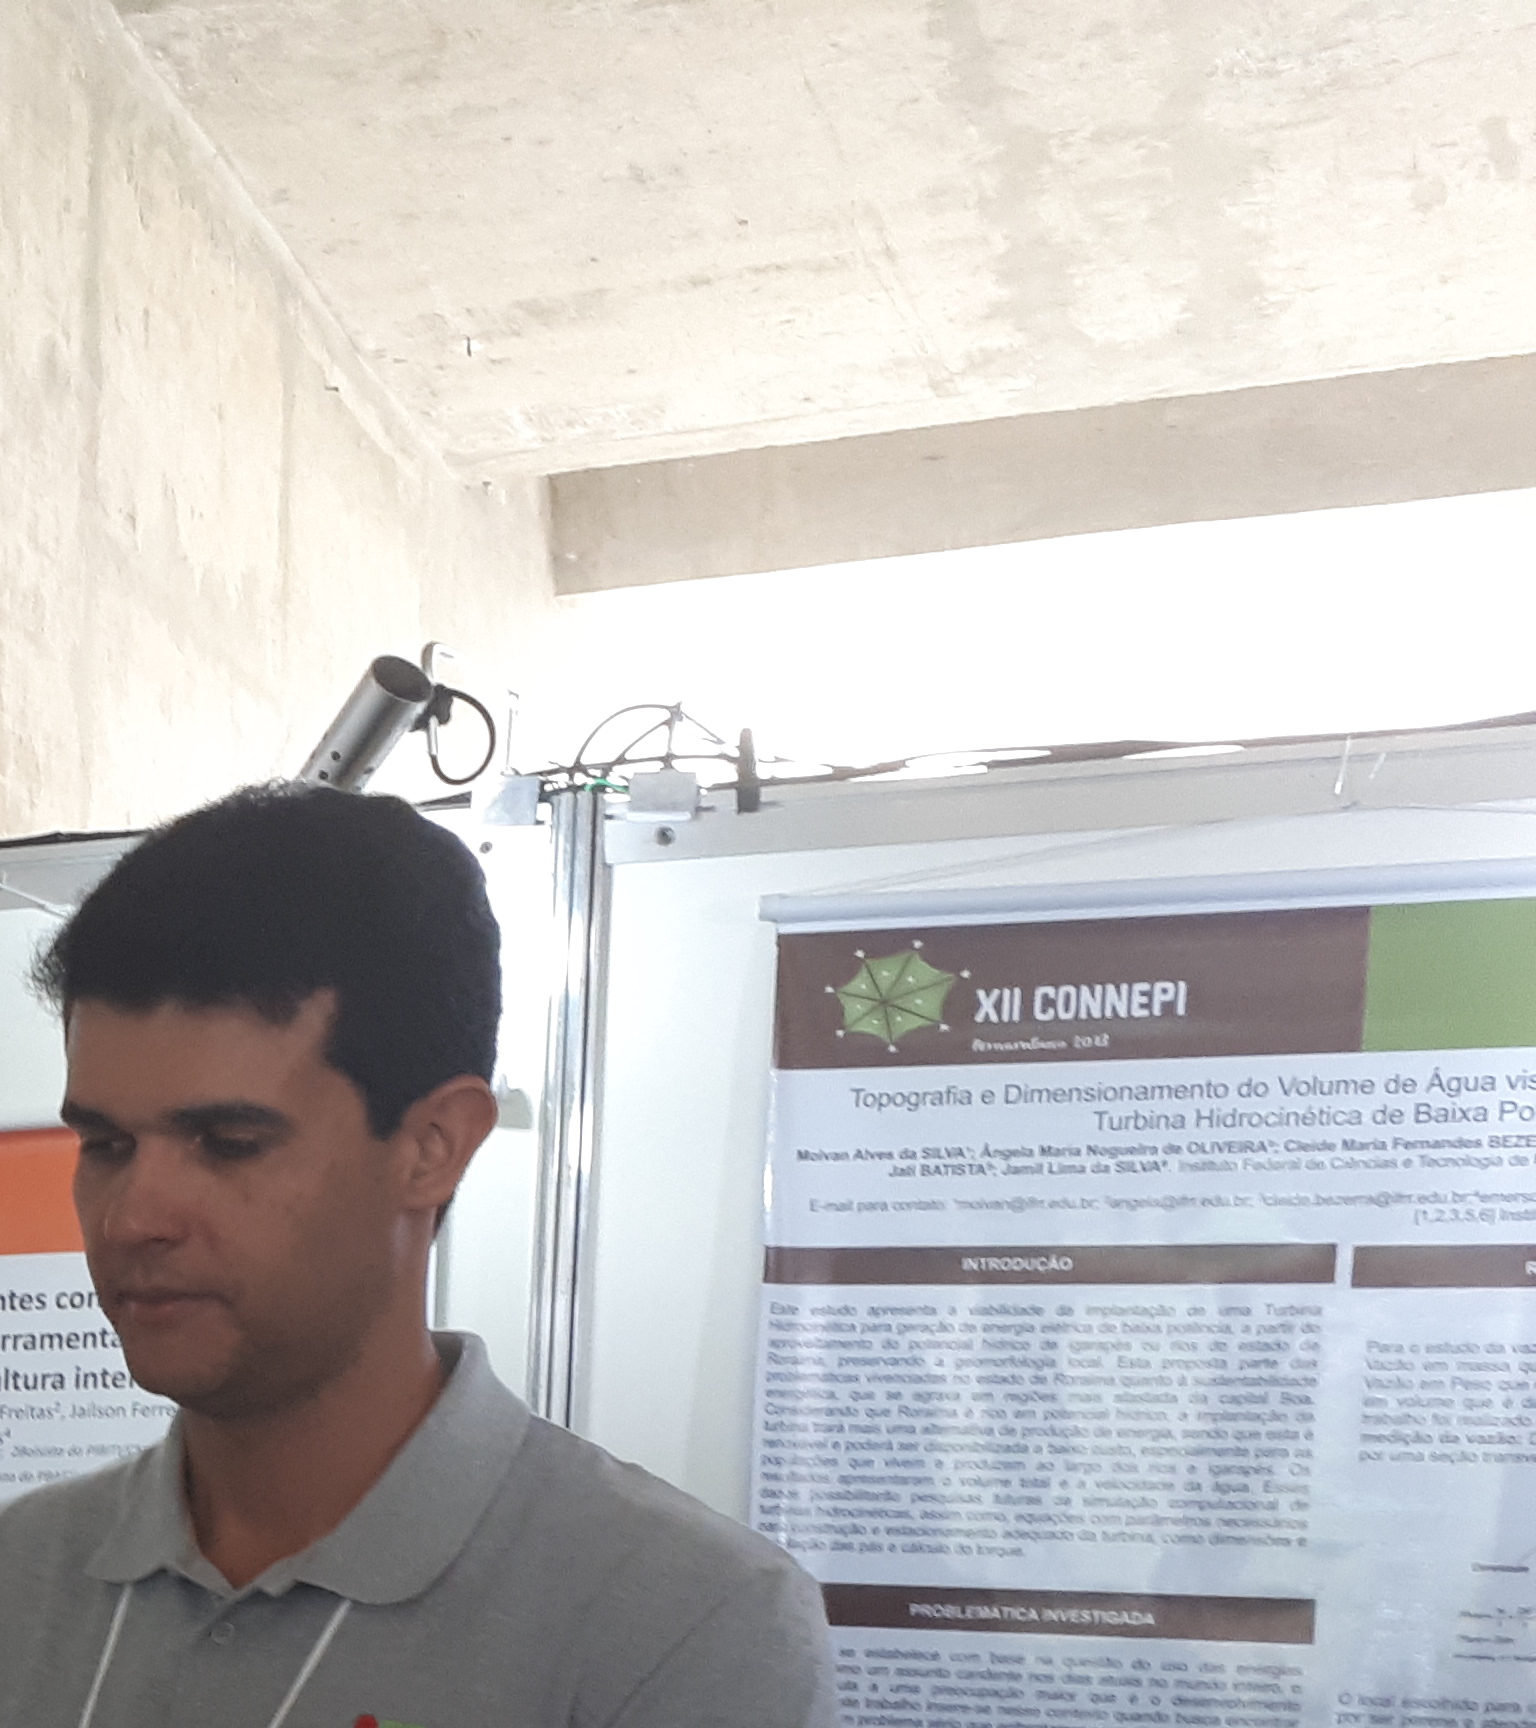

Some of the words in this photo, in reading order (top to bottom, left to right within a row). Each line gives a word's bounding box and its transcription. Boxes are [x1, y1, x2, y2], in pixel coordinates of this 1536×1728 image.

[974, 987, 1022, 1023] XII
[1033, 980, 1187, 1022] CONNEPI
[850, 1083, 972, 1113] Topografia
[981, 1088, 995, 1105] e
[1004, 1077, 1228, 1104] Dimensionamento
[1237, 1076, 1269, 1098] do
[1278, 1073, 1375, 1097] Volume
[1384, 1072, 1417, 1095] de
[1426, 1066, 1496, 1097] Água
[1094, 1108, 1186, 1132] Turbina
[1196, 1104, 1362, 1130] Hidrocinética
[1372, 1103, 1404, 1126] de
[1414, 1101, 1488, 1125] Baixa
[1498, 1100, 1535, 1123] Po
[961, 1254, 1073, 1273] INTRODUÇÃO
